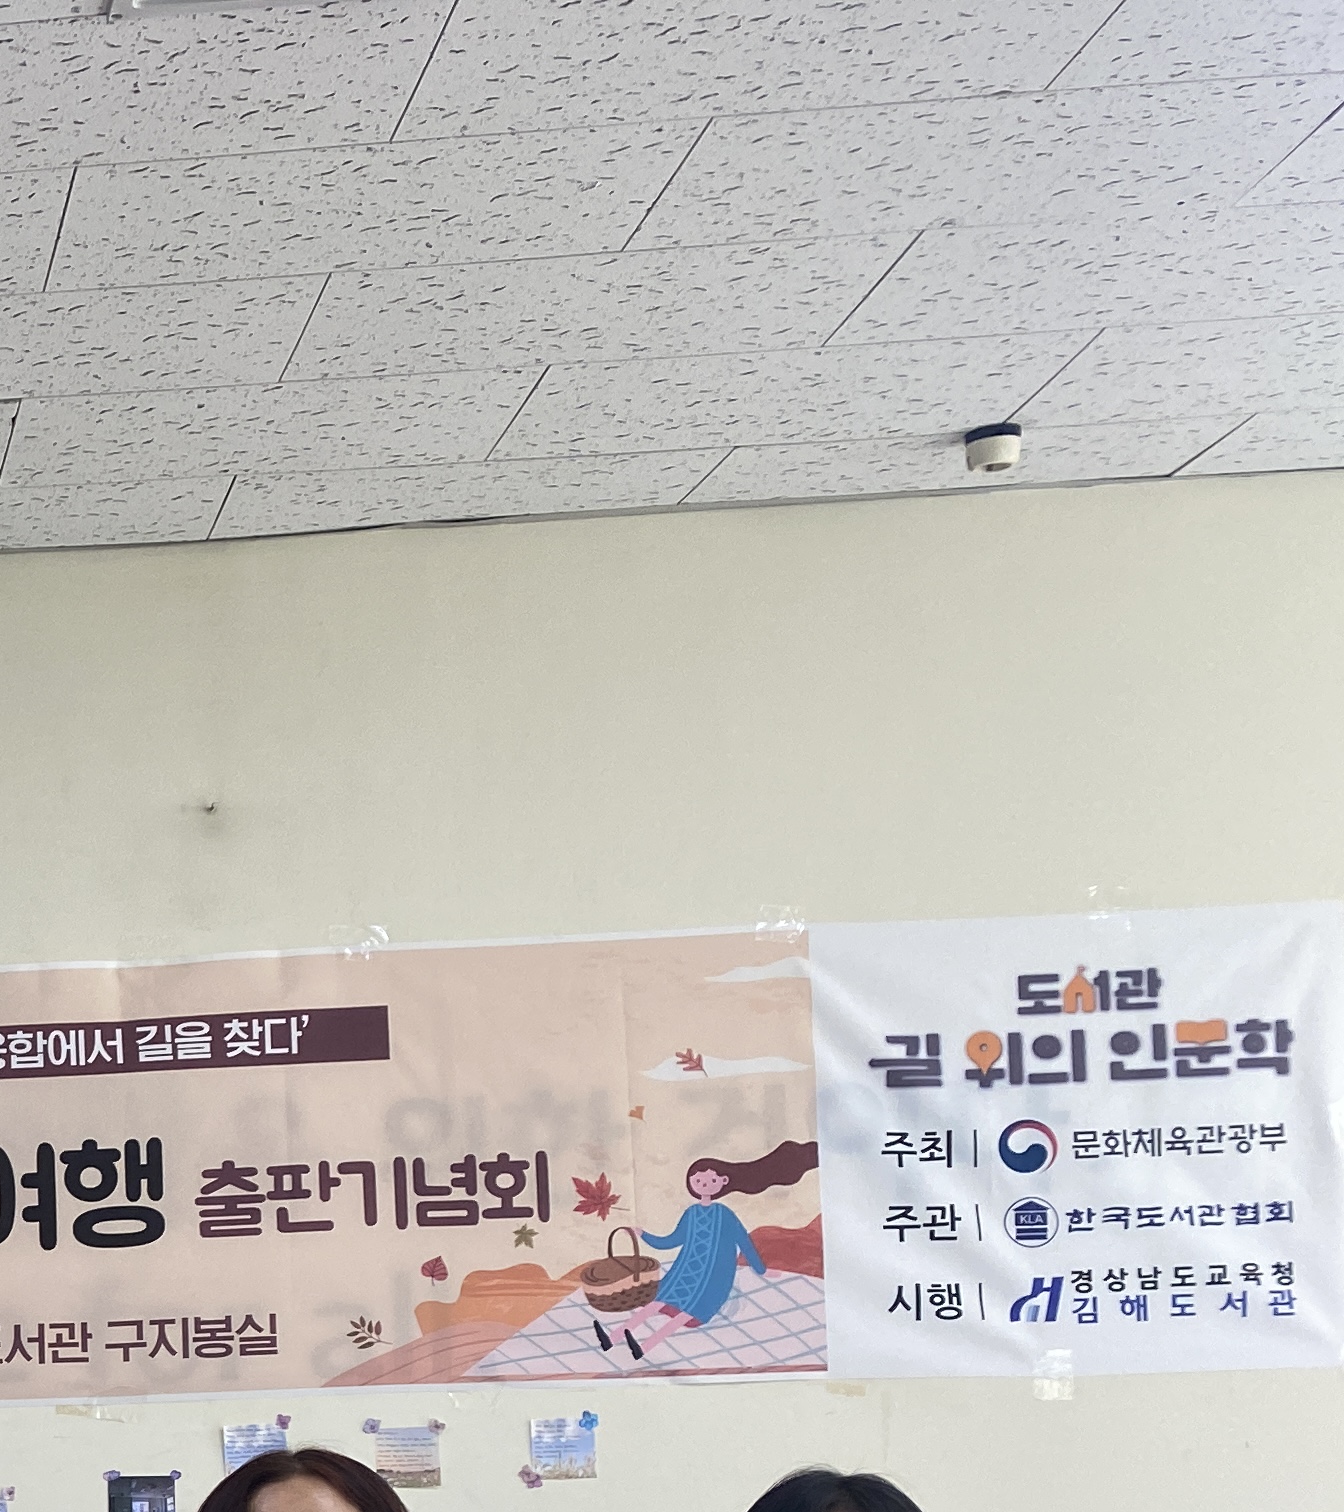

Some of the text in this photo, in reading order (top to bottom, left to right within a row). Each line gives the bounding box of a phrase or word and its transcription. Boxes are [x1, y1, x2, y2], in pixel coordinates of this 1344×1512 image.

[136, 1018, 214, 1061] 길을
[869, 1018, 1294, 1089] 길 위의 인문학
[881, 1122, 1287, 1168] 주최 문화체육관광부
[195, 1150, 551, 1240] 출판기념회
[883, 1199, 1295, 1242] 주관 한국도서관협회
[1019, 1212, 1045, 1226] KLA
[887, 1261, 1296, 1321] 시행 경상남도교육청
[1071, 1288, 1297, 1325] 김해도서관
[104, 1312, 279, 1363] 구지봉실
